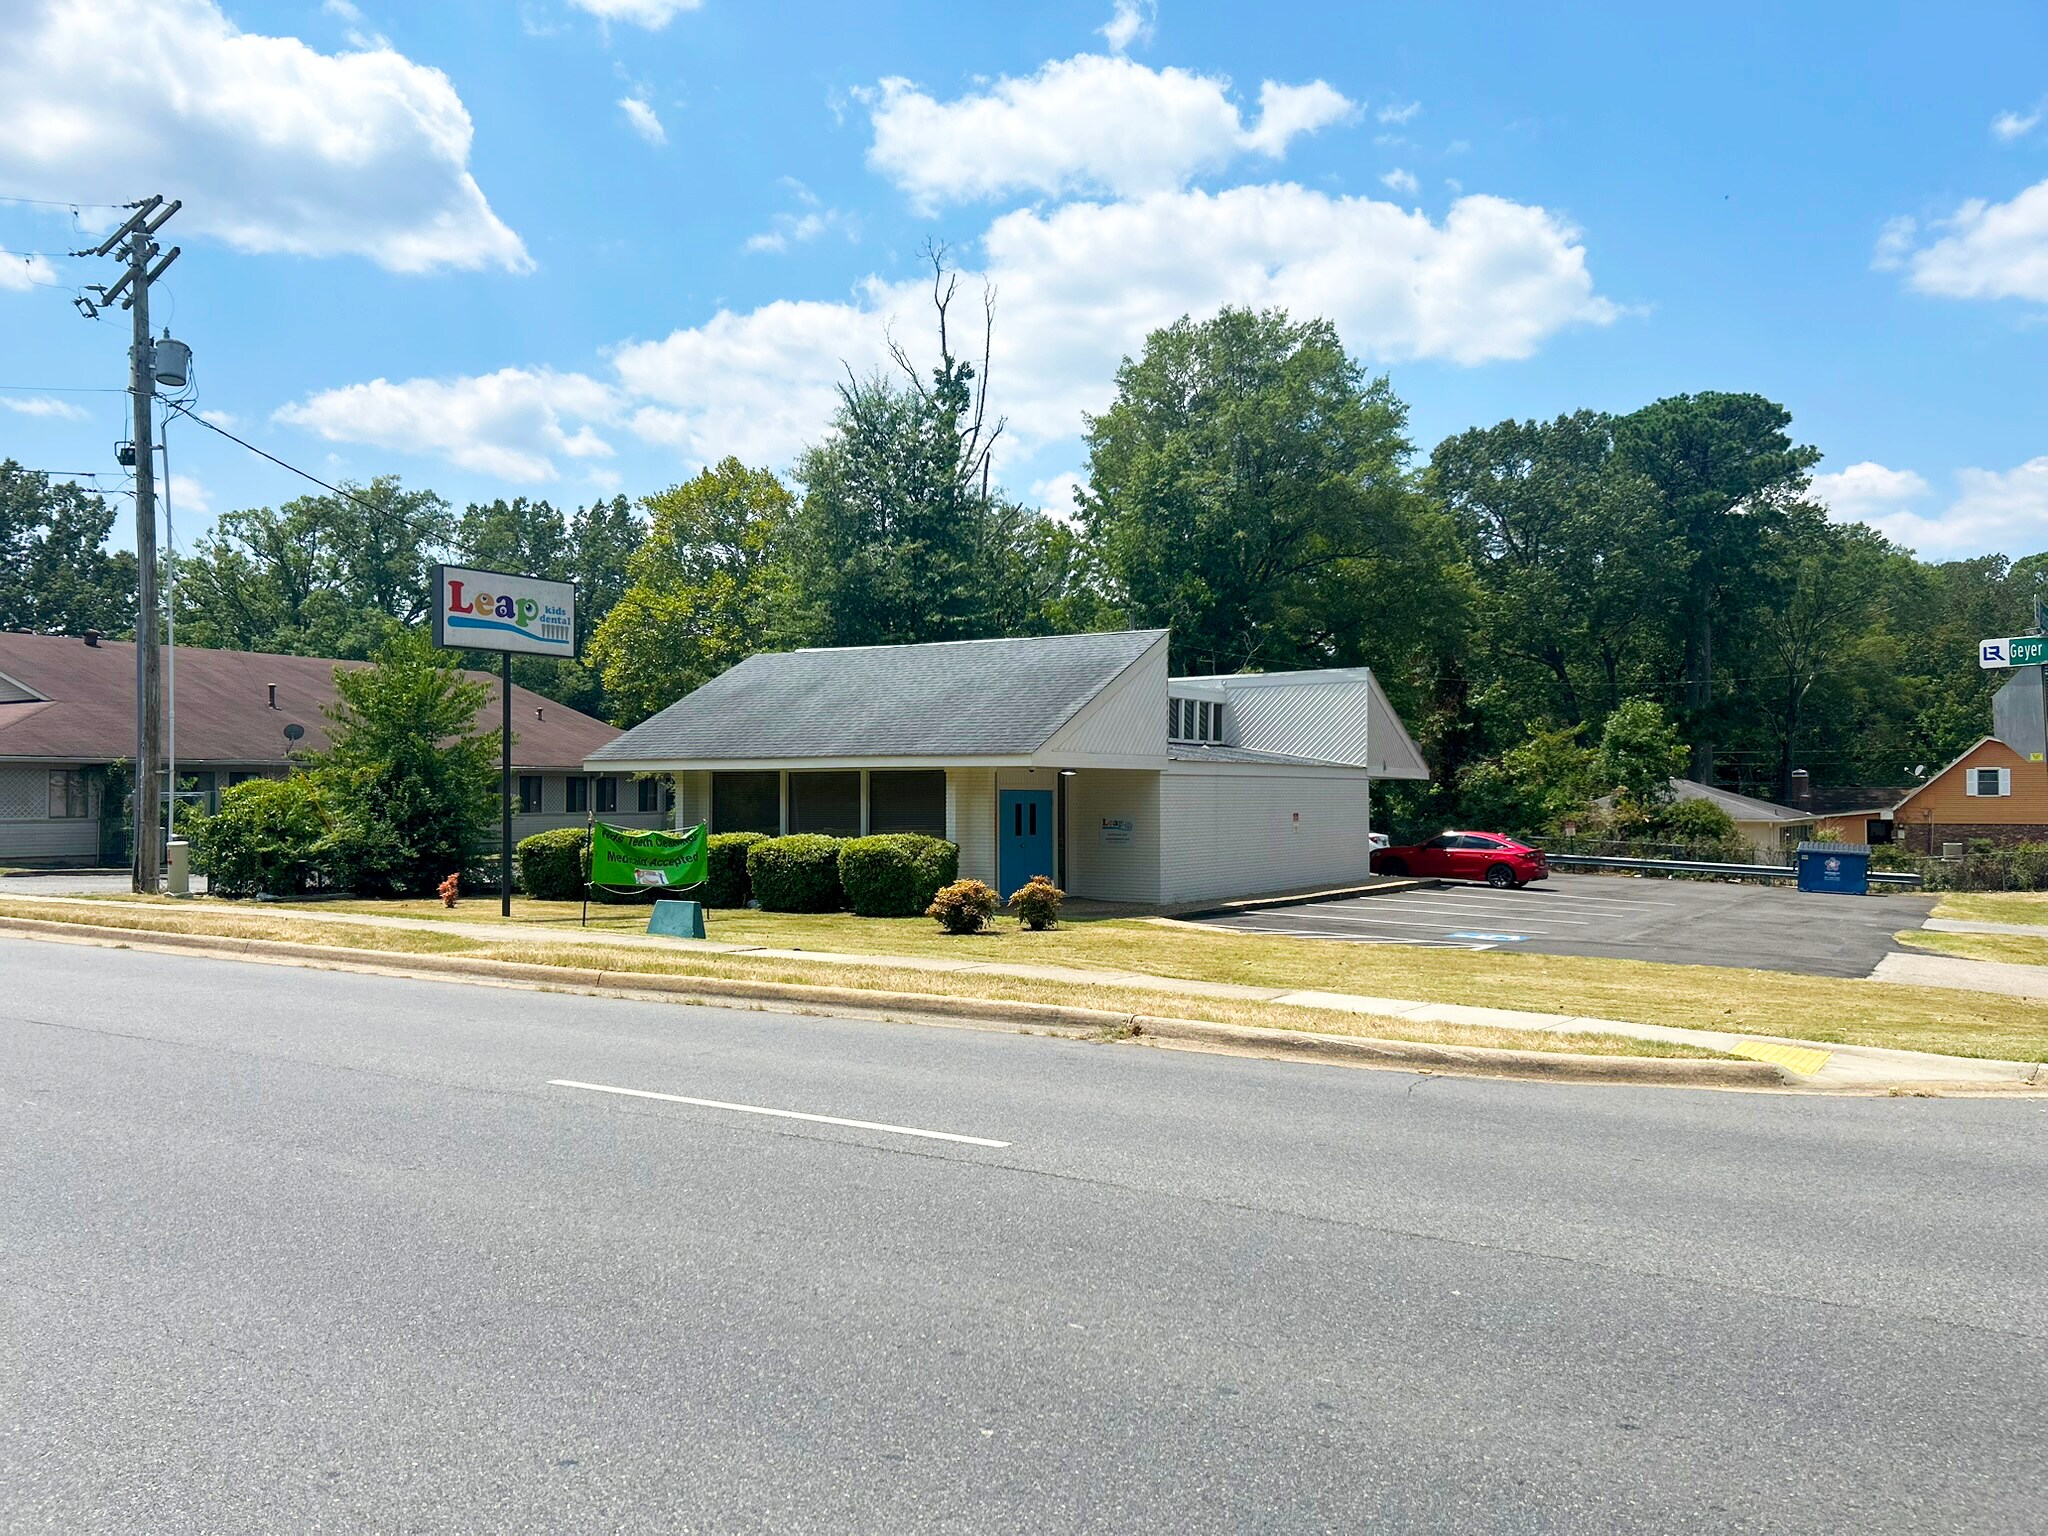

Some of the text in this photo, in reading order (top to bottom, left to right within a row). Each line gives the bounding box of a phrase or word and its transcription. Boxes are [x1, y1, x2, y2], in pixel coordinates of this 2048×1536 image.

[448, 580, 539, 627] Leap
[545, 605, 567, 616] kids
[540, 614, 571, 626] dental
[2010, 643, 2043, 661] Geyer
[628, 836, 653, 847] Teeth
[607, 850, 699, 868] Medicaid Accepted
